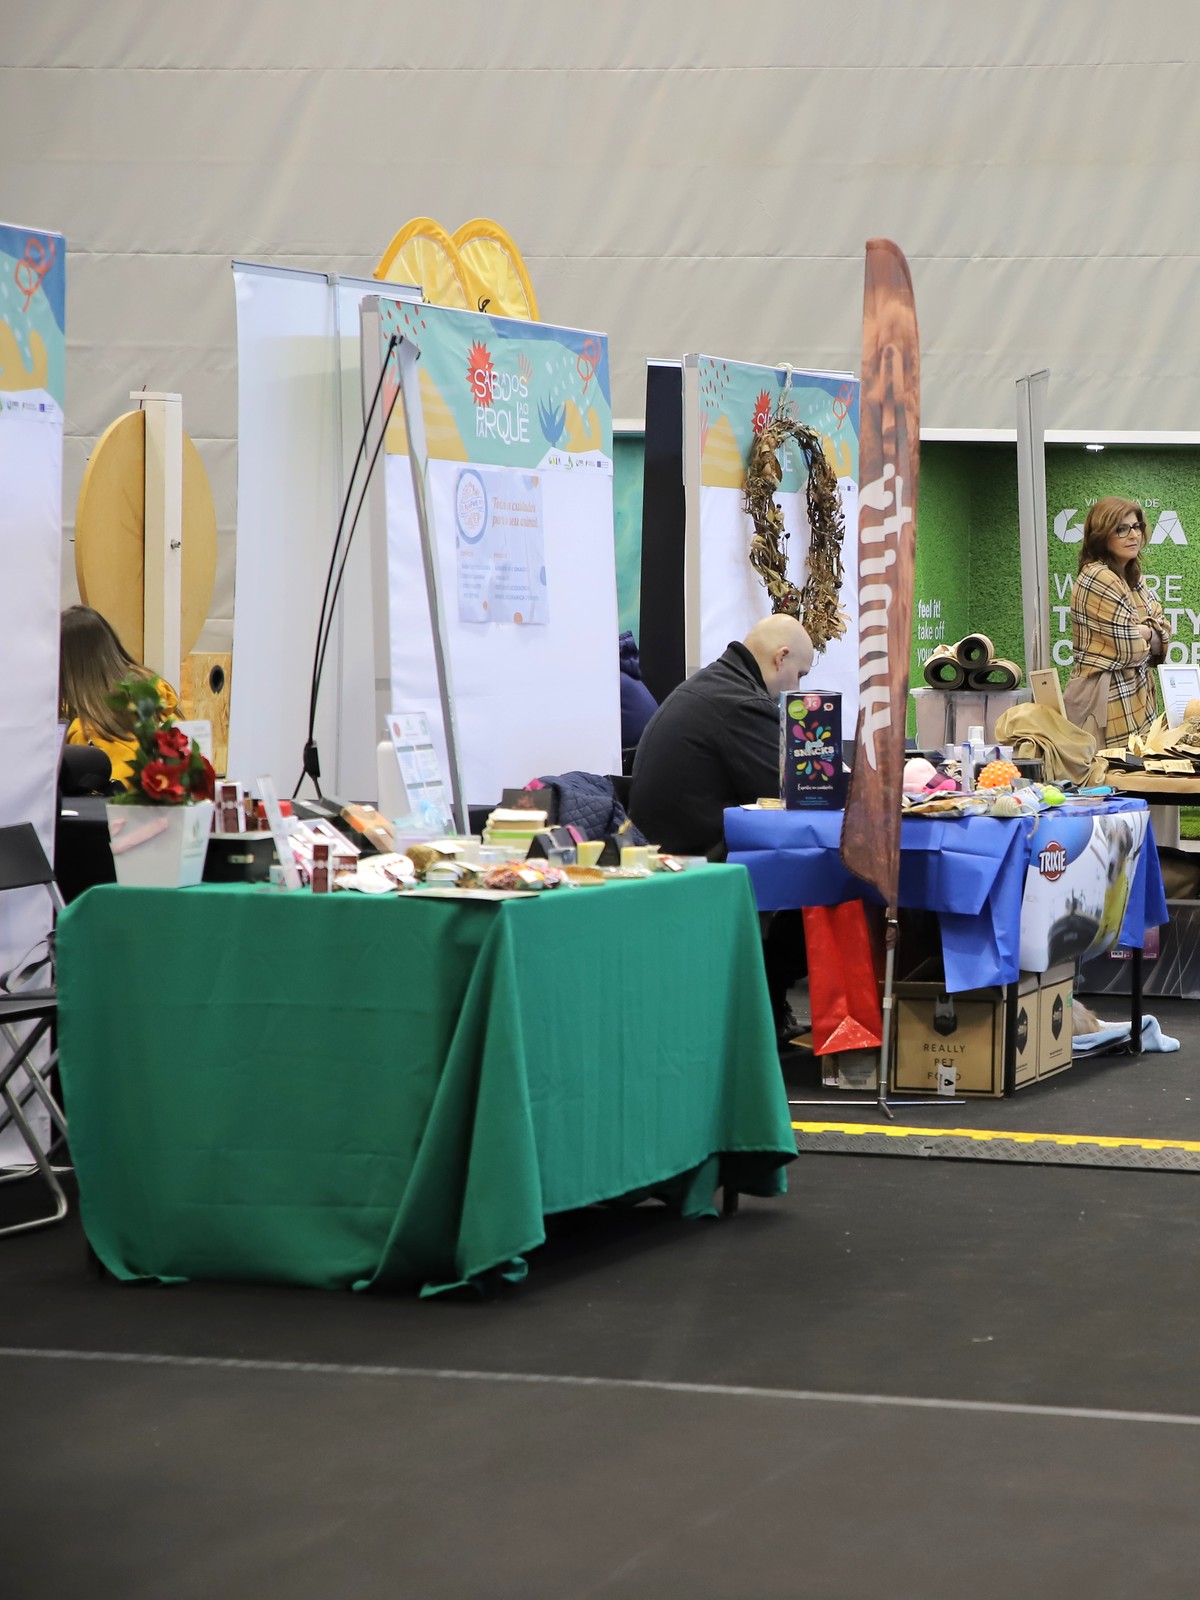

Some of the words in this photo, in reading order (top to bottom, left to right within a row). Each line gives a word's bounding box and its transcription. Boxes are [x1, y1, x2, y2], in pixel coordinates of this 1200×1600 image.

[475, 401, 530, 445] PARQUE
[1144, 498, 1160, 508] DE
[918, 599, 932, 619] feel
[932, 599, 941, 619] it!
[917, 621, 933, 640] take
[934, 620, 945, 640] off
[1039, 850, 1066, 873] TRIXIE
[923, 1043, 966, 1053] REALLY
[934, 1058, 955, 1067] PET
